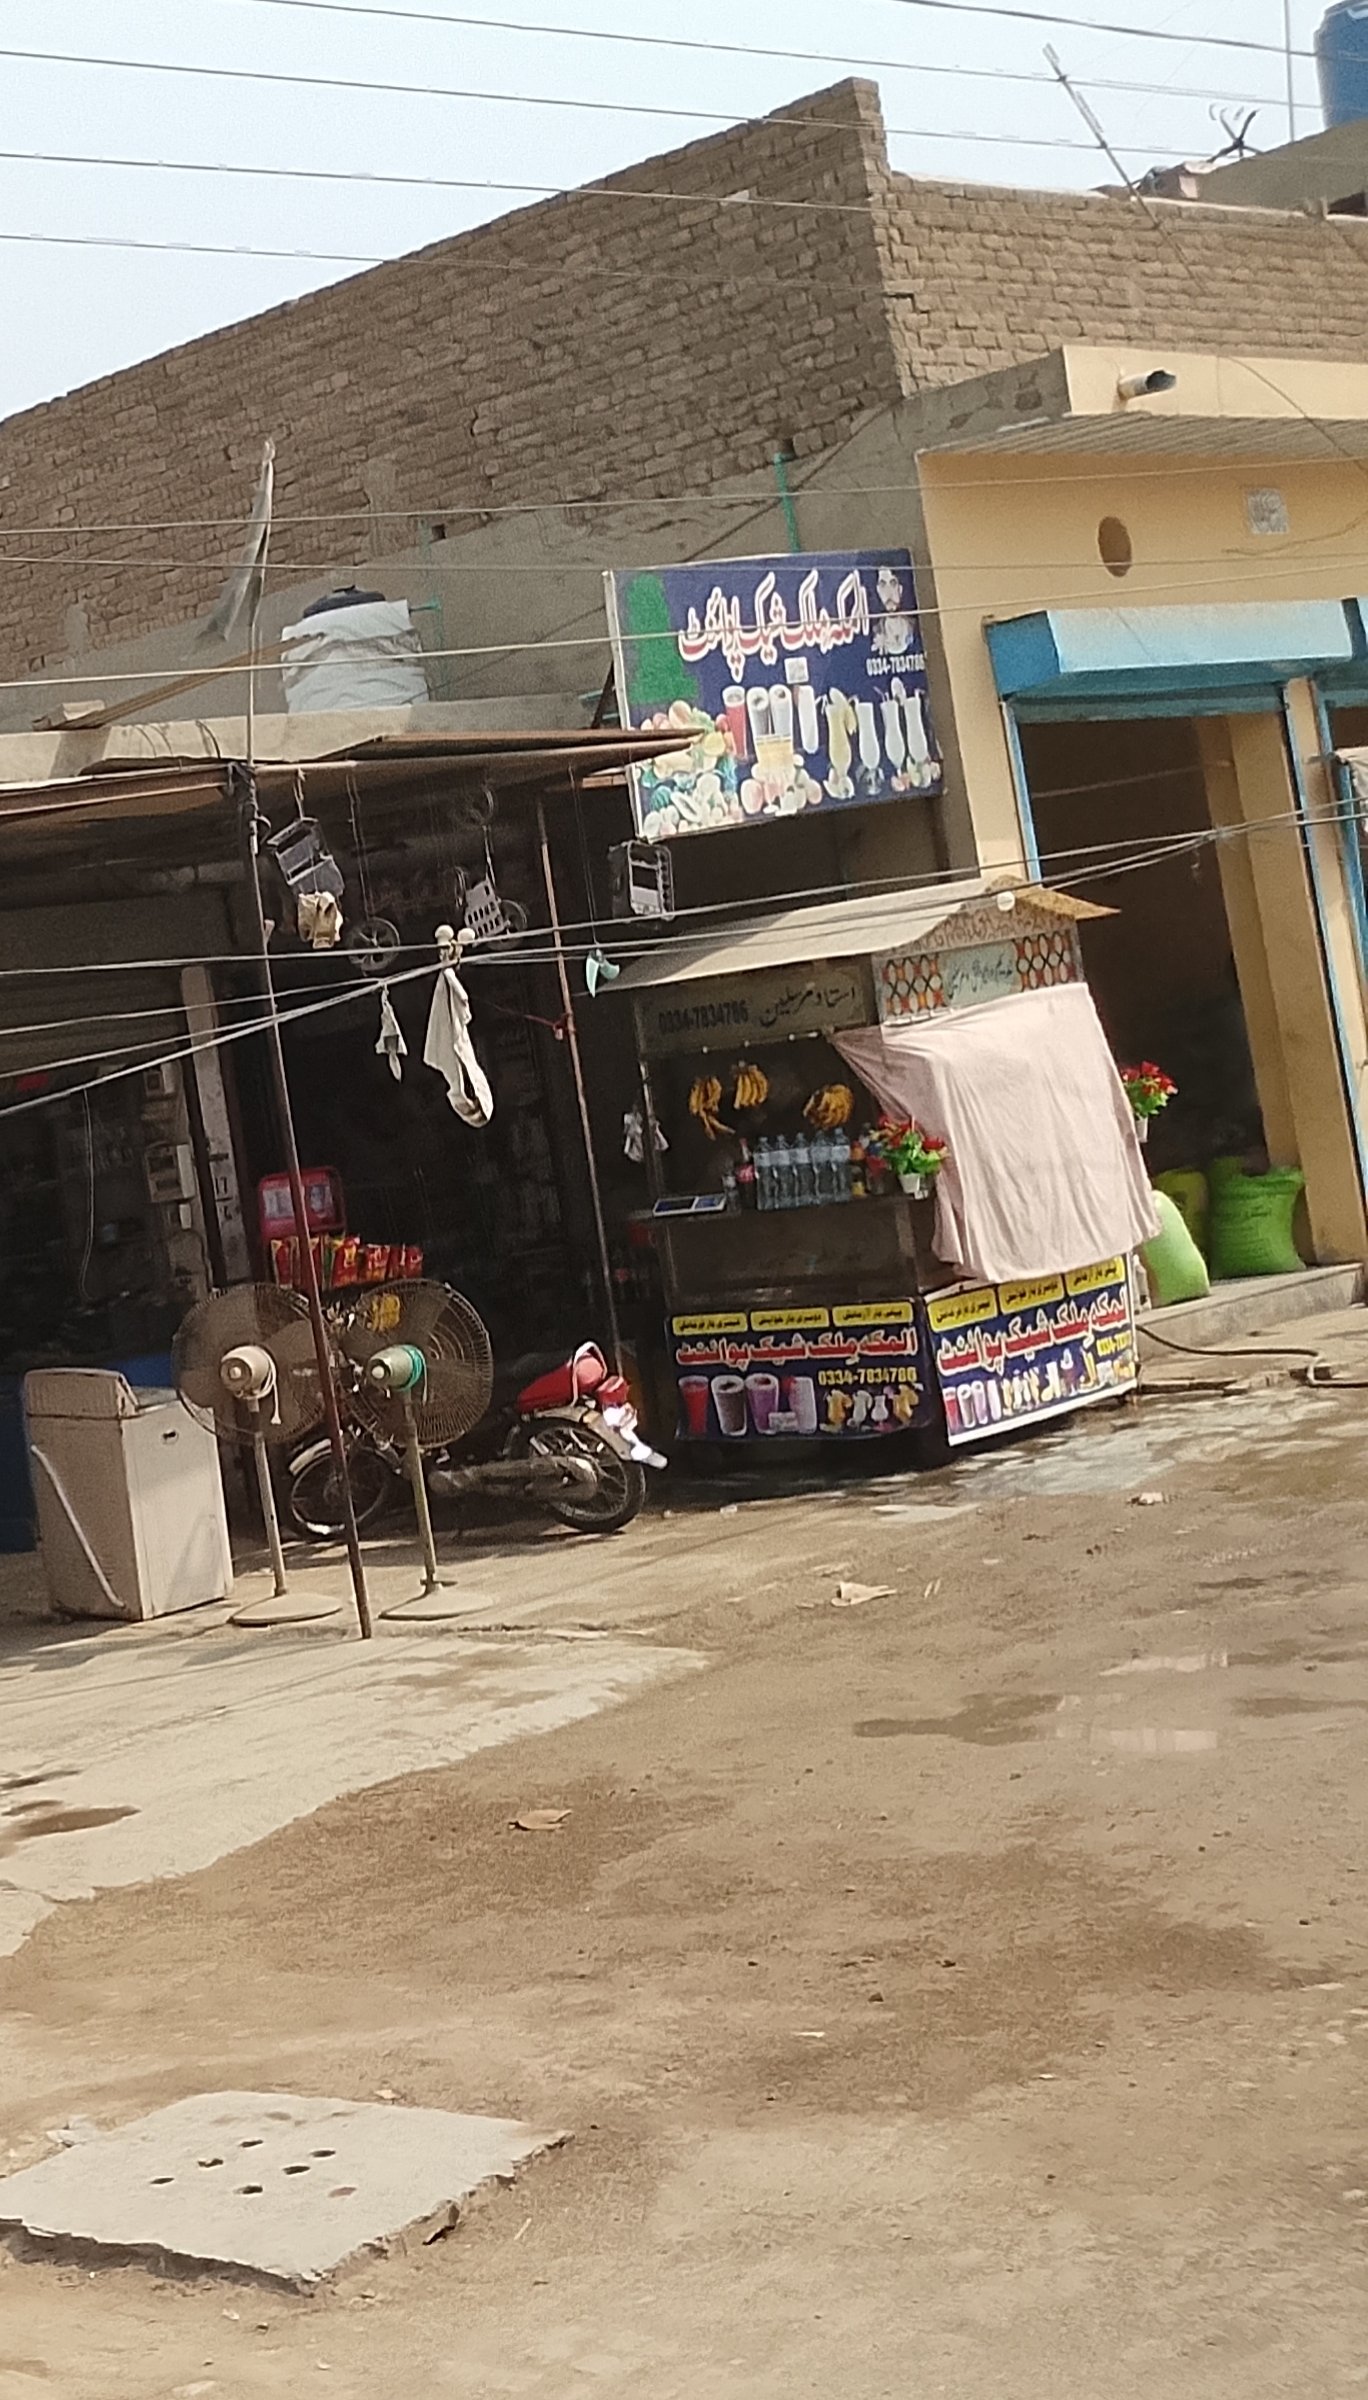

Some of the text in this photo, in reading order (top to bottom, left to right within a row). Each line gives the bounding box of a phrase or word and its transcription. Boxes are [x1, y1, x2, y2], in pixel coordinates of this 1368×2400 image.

[748, 1333, 808, 1366] شیک
[859, 1327, 918, 1356] المکہ
[1002, 1308, 1054, 1362] شیک
